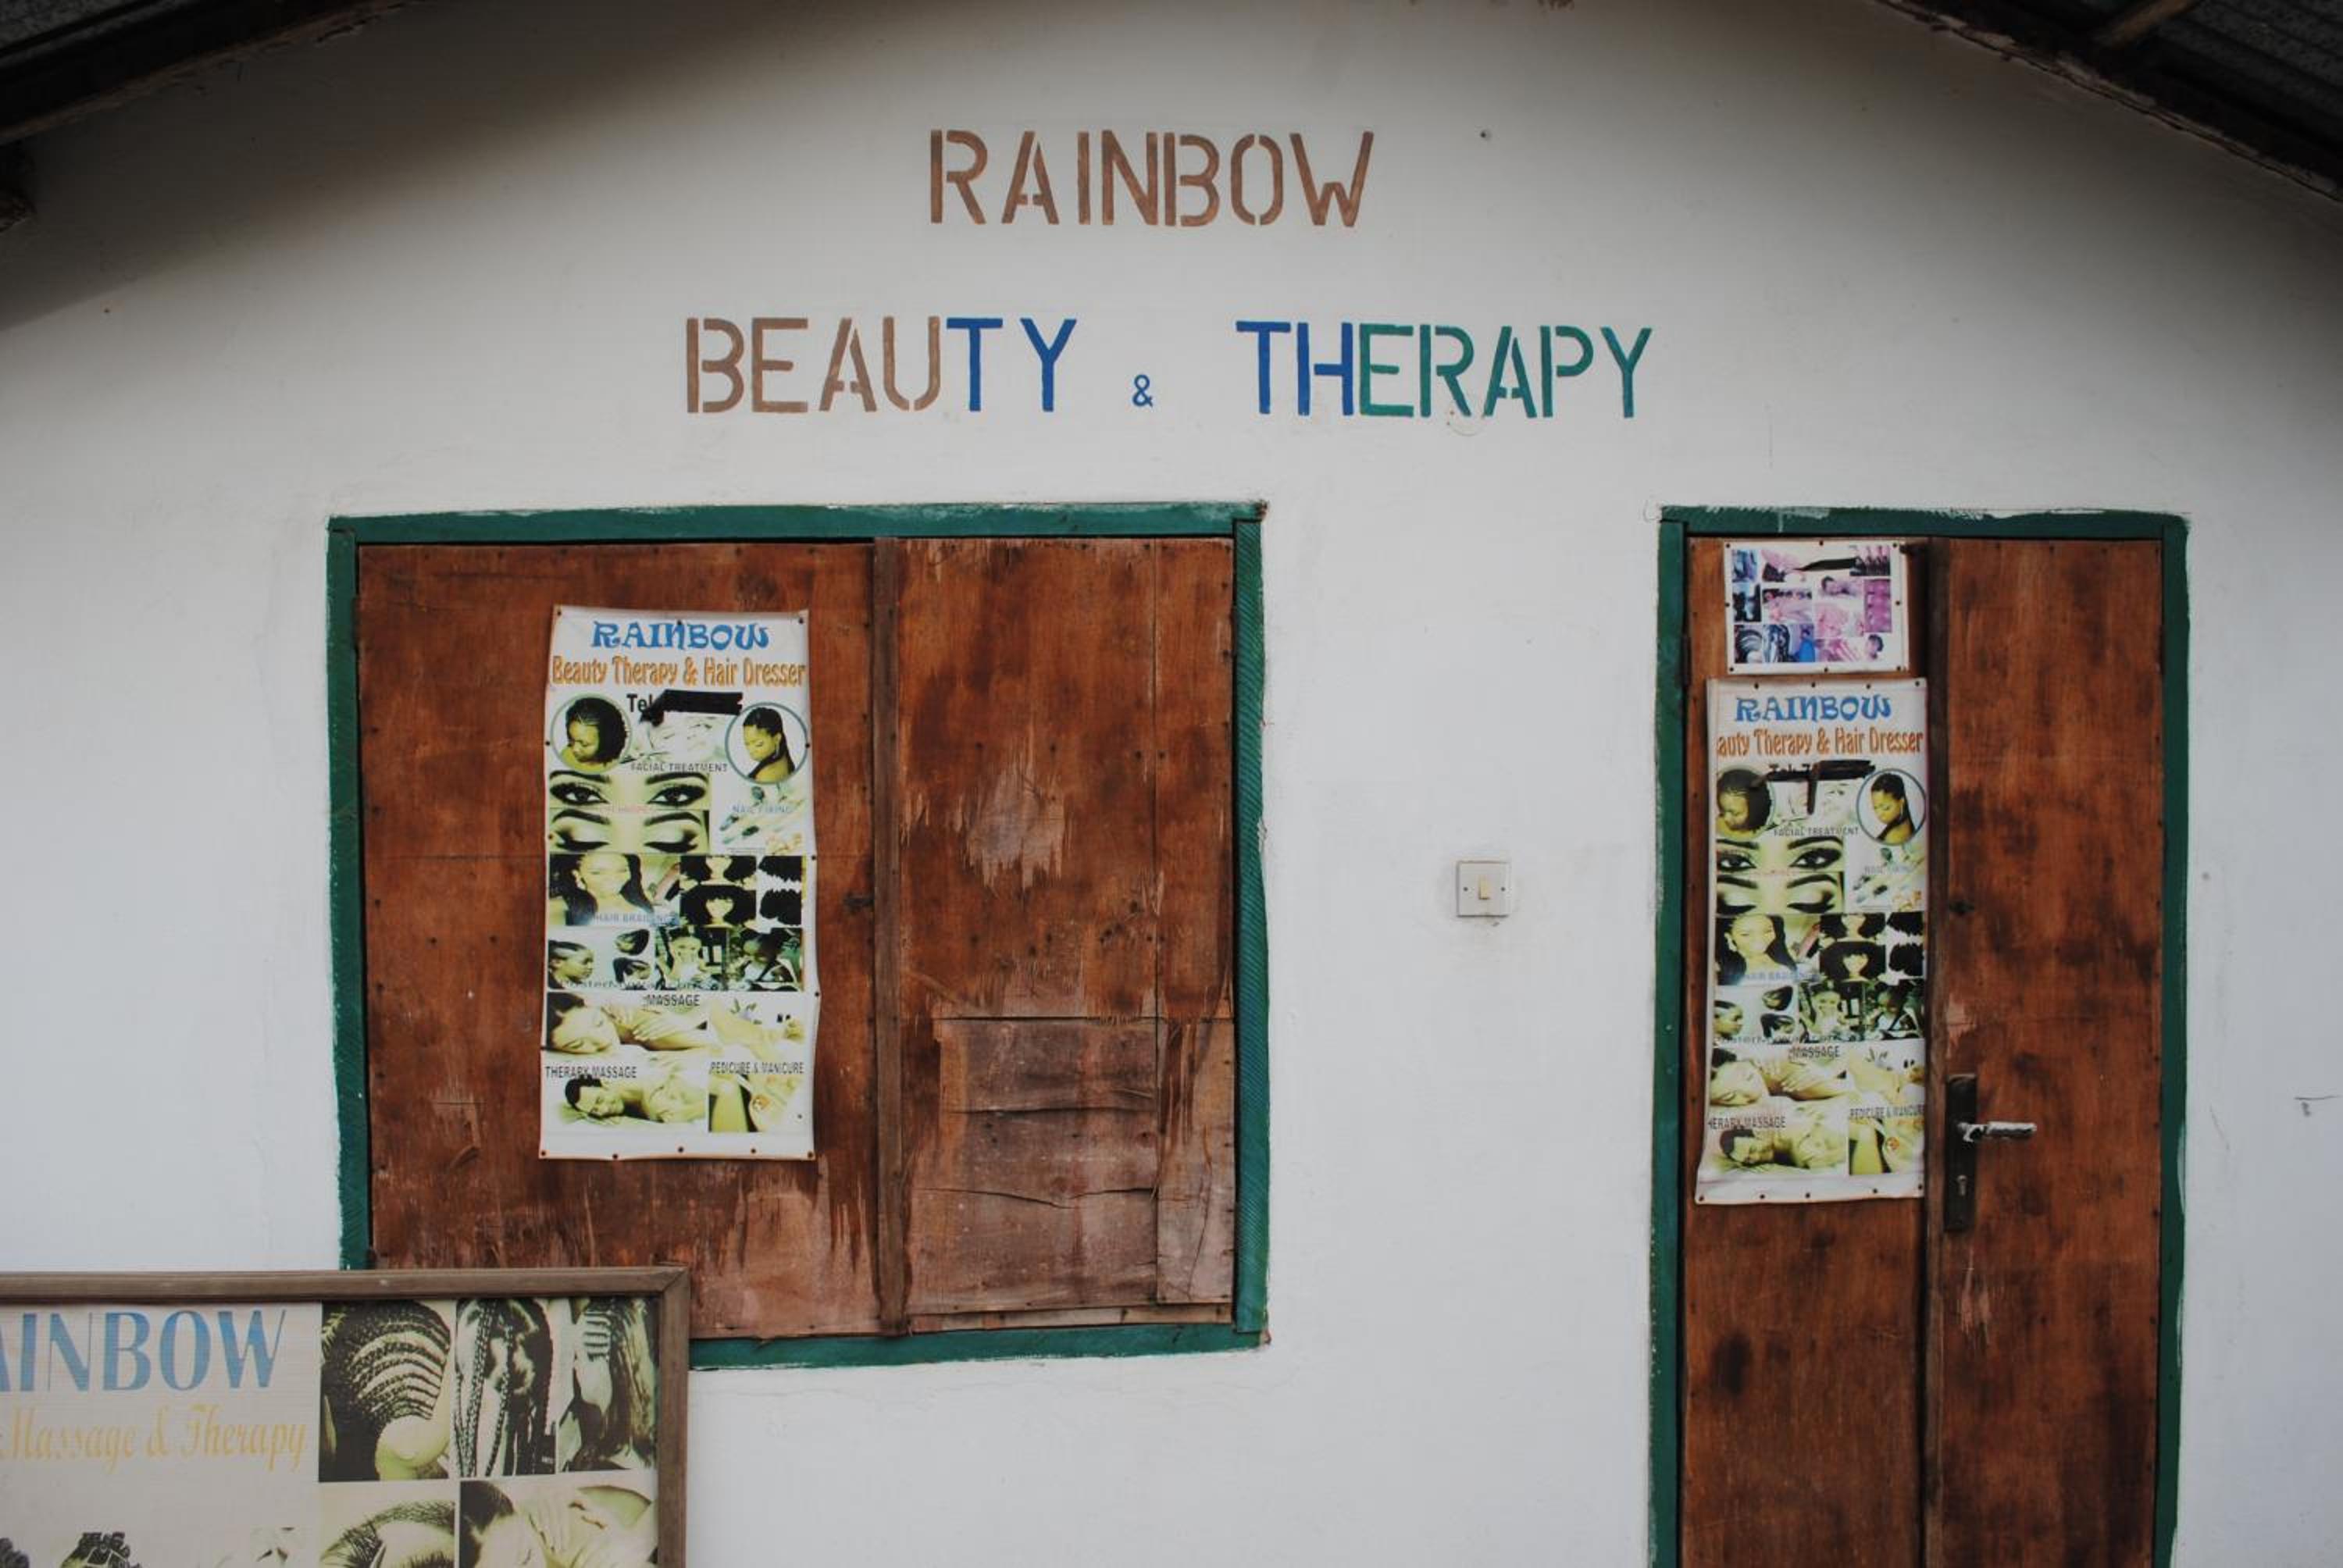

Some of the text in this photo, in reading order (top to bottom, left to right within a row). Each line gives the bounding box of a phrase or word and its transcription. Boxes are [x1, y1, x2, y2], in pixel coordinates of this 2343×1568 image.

[930, 130, 1373, 226] RAINBOW
[686, 317, 1652, 419] BEAUTY & THERAPY
[591, 621, 770, 650] RAINBOW
[551, 656, 806, 688] Beauty Therapy & Hair Dresser
[1735, 693, 1892, 723] RAINBOW
[1753, 728, 1812, 756] Therapy
[1817, 727, 1830, 755] &
[1835, 726, 1865, 755] Hair
[1869, 726, 1924, 754] Dresser
[630, 762, 728, 773] FACIAL TREATMENT
[1774, 825, 1859, 838] FACIAL TREATMENT
[645, 994, 701, 1007] MASSAGE
[1789, 1046, 1840, 1059] MASSAGE
[545, 1066, 637, 1078] THERAPY MASSAGE
[709, 1061, 751, 1074] PEDICURE
[761, 1062, 804, 1074] MANICURE
[1743, 1116, 1786, 1129] MASSAGE
[2, 1404, 138, 1474] Massage
[180, 1403, 308, 1473] Therapy
